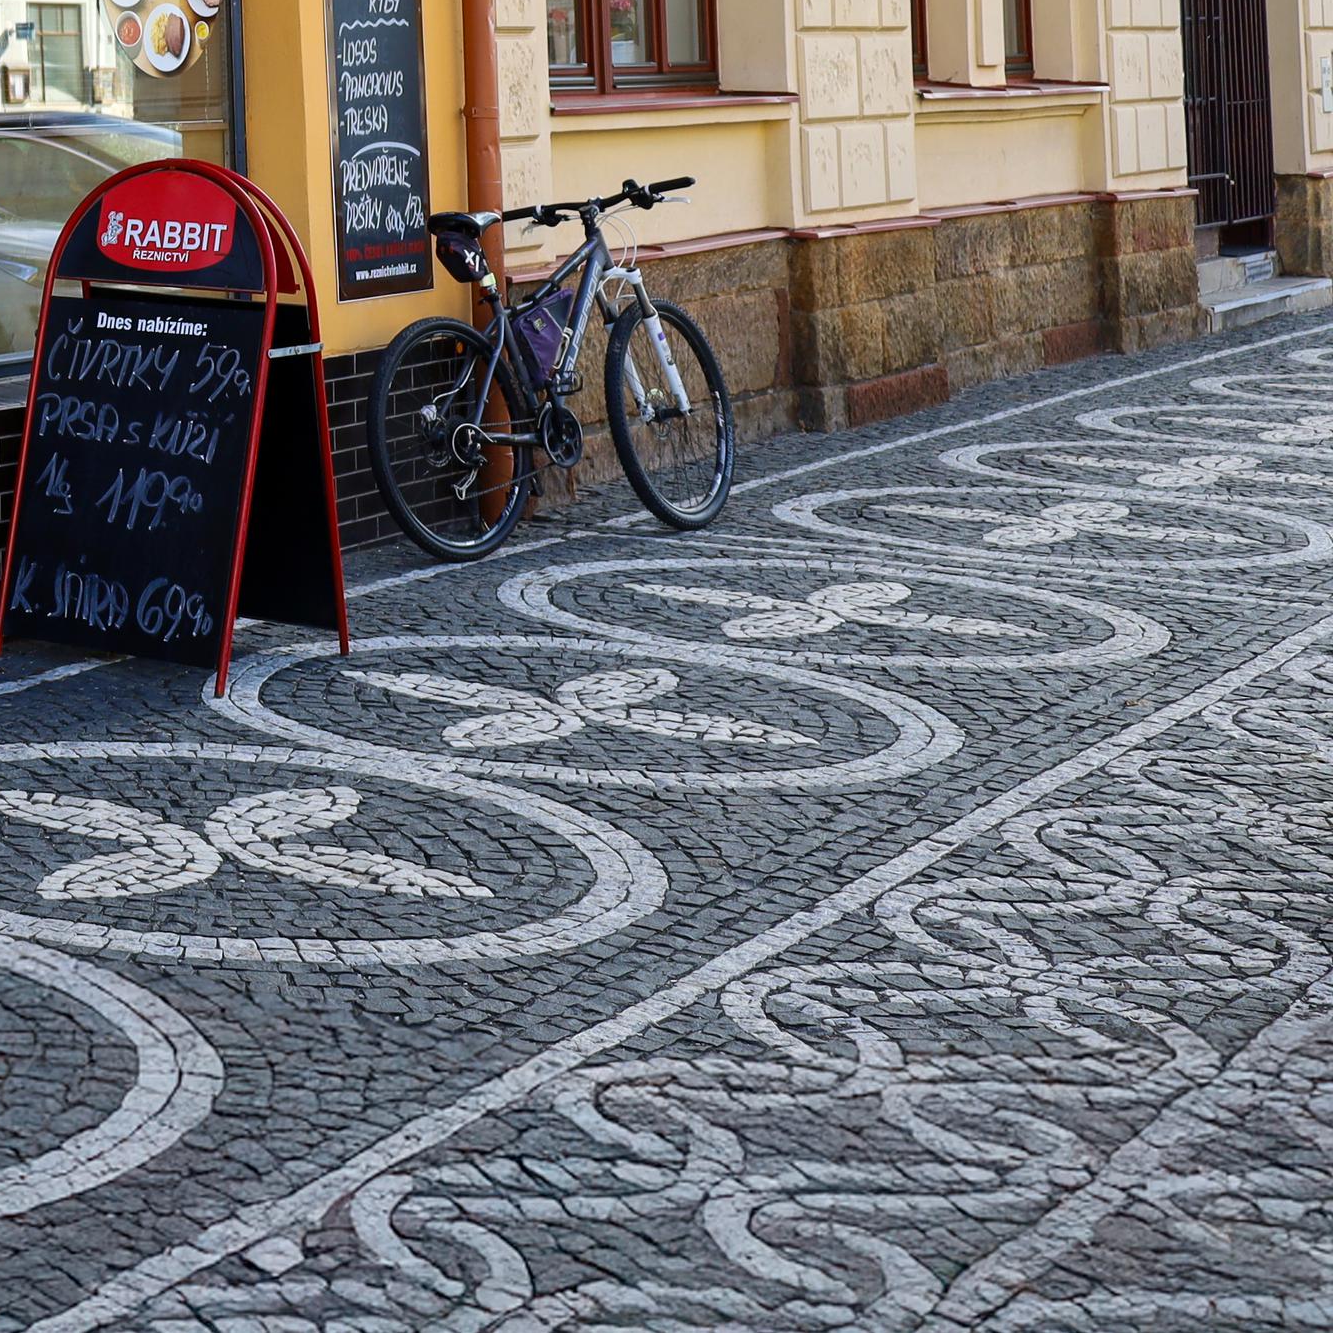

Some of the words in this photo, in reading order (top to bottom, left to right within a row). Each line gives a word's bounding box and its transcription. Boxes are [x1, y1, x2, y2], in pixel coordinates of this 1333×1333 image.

[124, 219, 228, 252] RABBIT
[132, 249, 189, 263] ŘEZNICTVÍ
[97, 312, 132, 332] Dnes
[136, 317, 208, 336] nabízíme:
